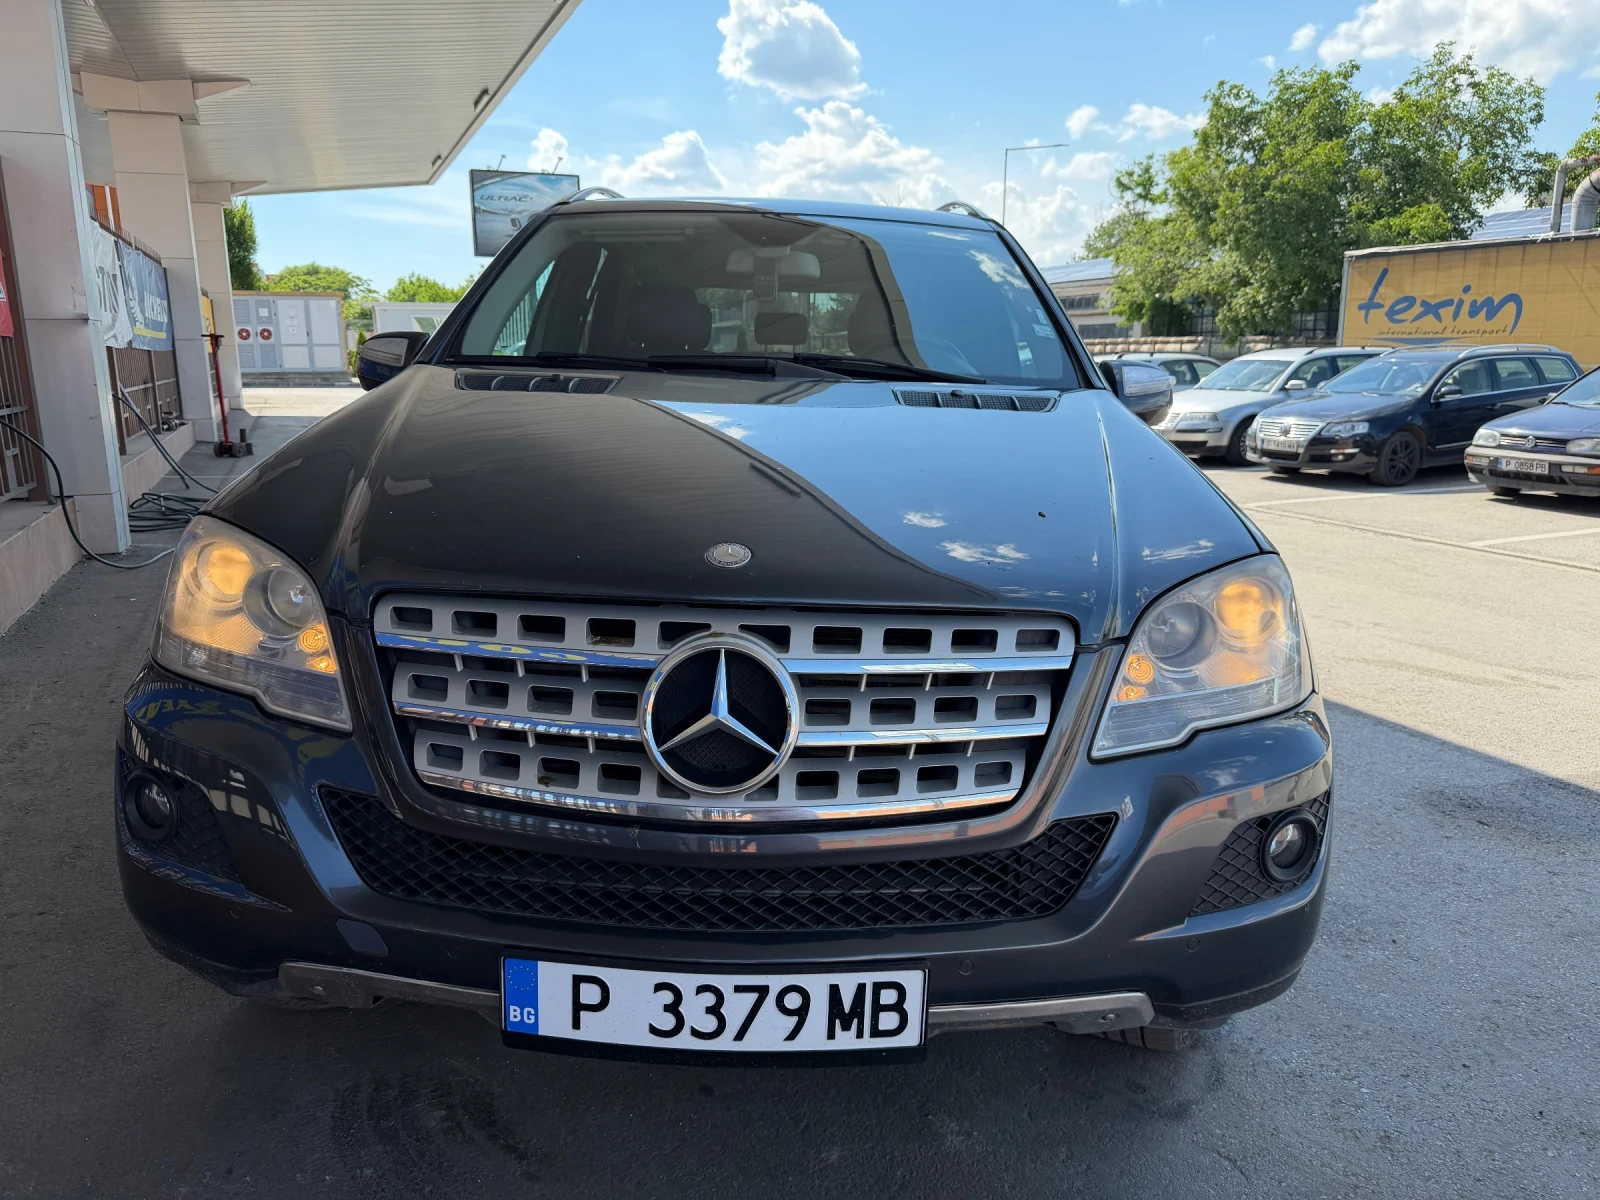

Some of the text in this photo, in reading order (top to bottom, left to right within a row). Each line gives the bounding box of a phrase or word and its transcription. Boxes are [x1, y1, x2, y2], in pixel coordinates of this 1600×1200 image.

[1357, 267, 1523, 336] texim
[1377, 324, 1508, 337] international transport
[1514, 461, 1534, 471] 0858
[509, 1005, 536, 1024] BG
[571, 973, 909, 1042] P 3379 MB
